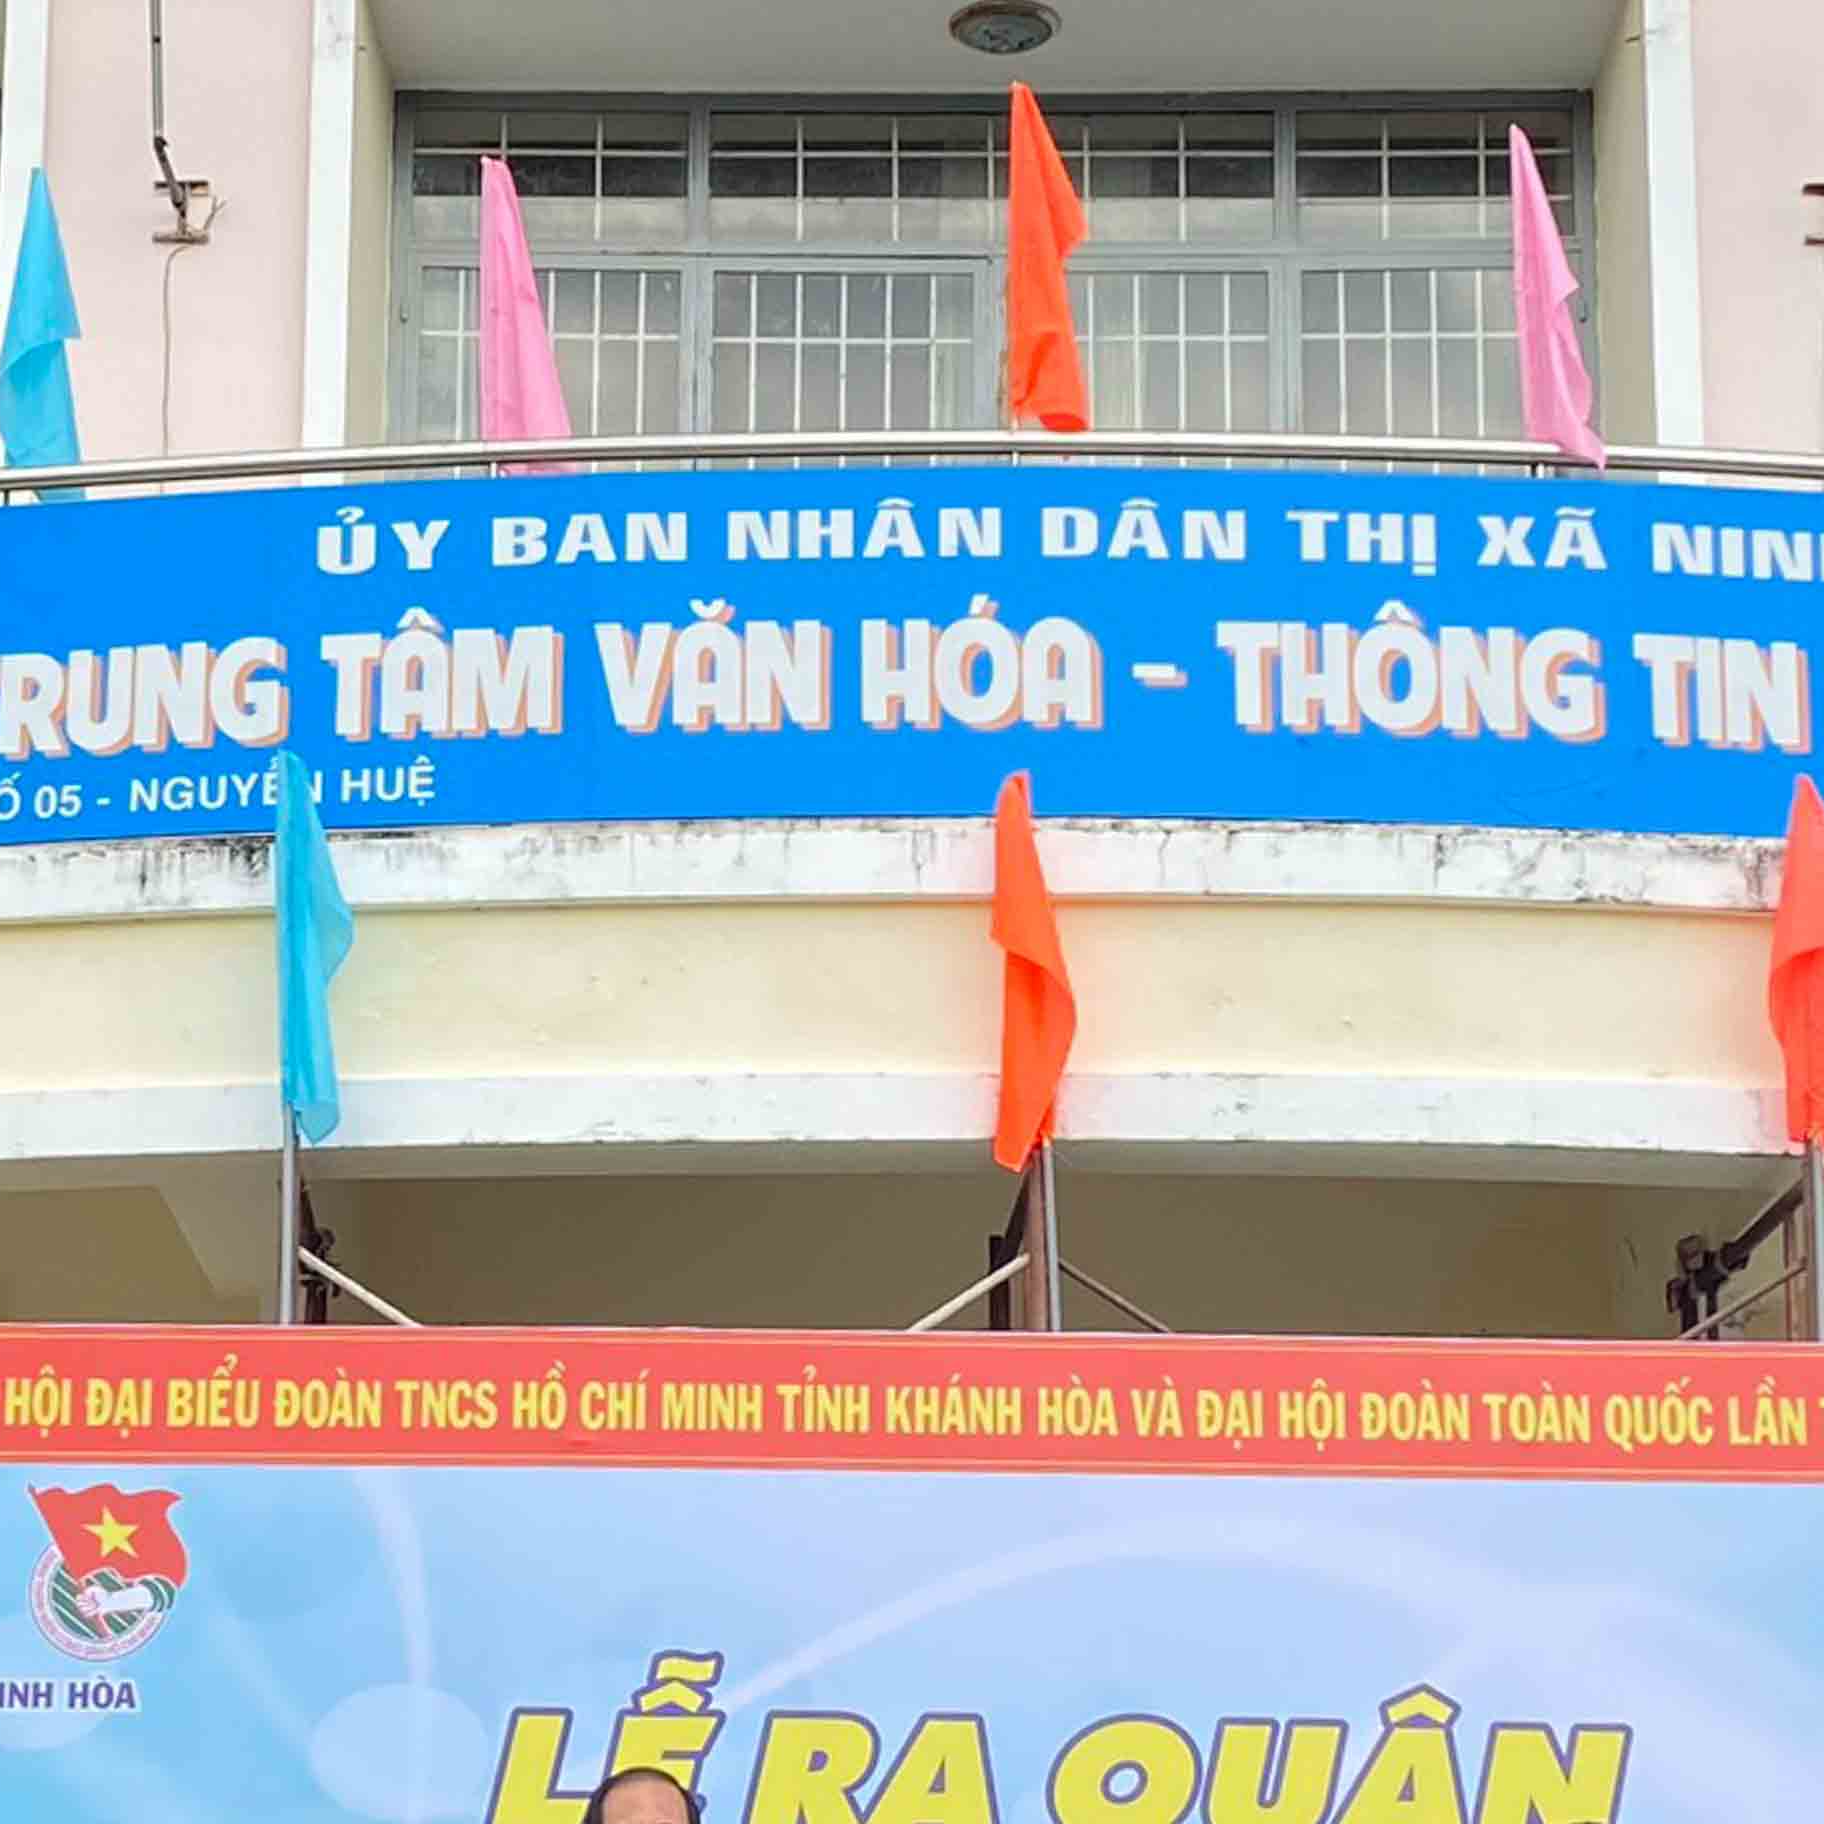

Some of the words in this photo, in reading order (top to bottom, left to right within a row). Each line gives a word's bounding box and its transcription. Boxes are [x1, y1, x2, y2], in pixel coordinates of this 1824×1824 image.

[317, 507, 449, 575] ỦY
[492, 512, 687, 566] BAN
[728, 499, 1001, 560] NHÂN
[1042, 498, 1247, 560] DÂN
[1287, 510, 1436, 575] THỊ
[1477, 507, 1607, 570] XÃ
[321, 607, 562, 740] TÂM
[594, 598, 831, 733] VĂN
[860, 594, 1103, 731] HÓA
[1216, 600, 1606, 741] THÔNG
[1632, 633, 1812, 754] TIN
[34, 784, 82, 819] 05
[342, 756, 435, 805] HUỆ
[4, 1365, 72, 1438] HỘI
[84, 1377, 153, 1438] ĐẠI
[167, 1353, 260, 1429] BIỂU
[273, 1362, 381, 1430] ĐOÀN
[396, 1380, 498, 1430] TNCS
[513, 1360, 568, 1431] HỒ
[580, 1370, 648, 1432] CHÍ
[662, 1383, 764, 1433] MINH
[777, 1365, 870, 1435] TỈNH
[885, 1375, 1022, 1436] KHÁNH
[1037, 1373, 1119, 1437] HÒA
[1132, 1377, 1184, 1438] VÀ
[1196, 1390, 1263, 1451] ĐẠI
[1278, 1378, 1346, 1452] HỘI
[1359, 1379, 1471, 1443] ĐOÀN
[1483, 1379, 1590, 1445] TOÀN
[1604, 1376, 1713, 1450] QUỐC
[1729, 1375, 1808, 1447] LẦN
[68, 1675, 136, 1709] HÒA
